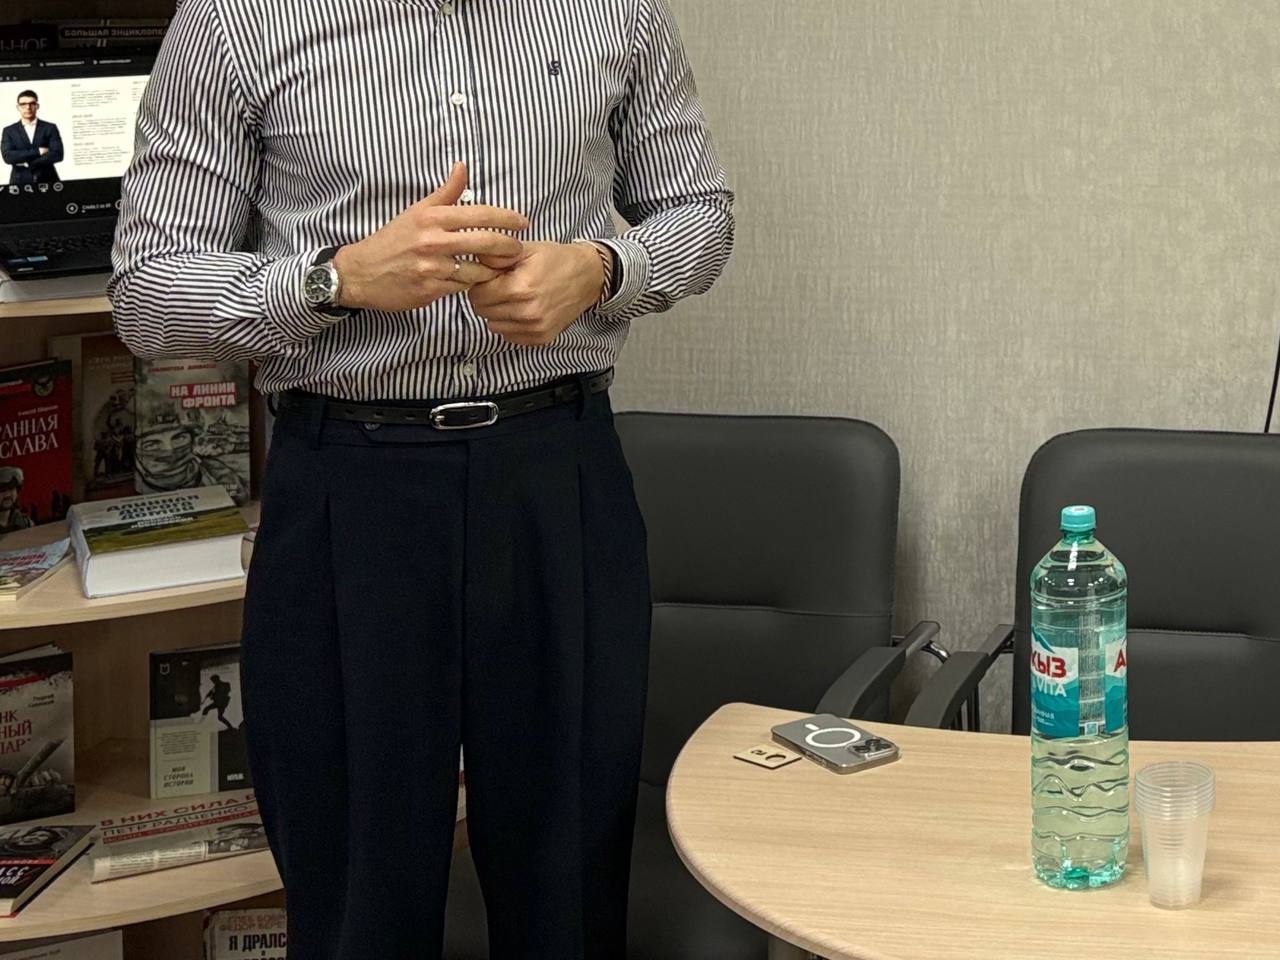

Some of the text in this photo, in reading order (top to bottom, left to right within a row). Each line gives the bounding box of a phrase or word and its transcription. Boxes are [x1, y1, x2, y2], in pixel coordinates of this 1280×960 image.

[64, 29, 110, 38] БОЛЬШАЯ
[171, 382, 236, 397] НА ЛИНИИ
[182, 394, 236, 408] ФРОНТА
[0, 431, 59, 459] СЛАВА
[101, 798, 239, 827] В НИХ СИЛА
[229, 932, 287, 952] Я ДРАЛС
